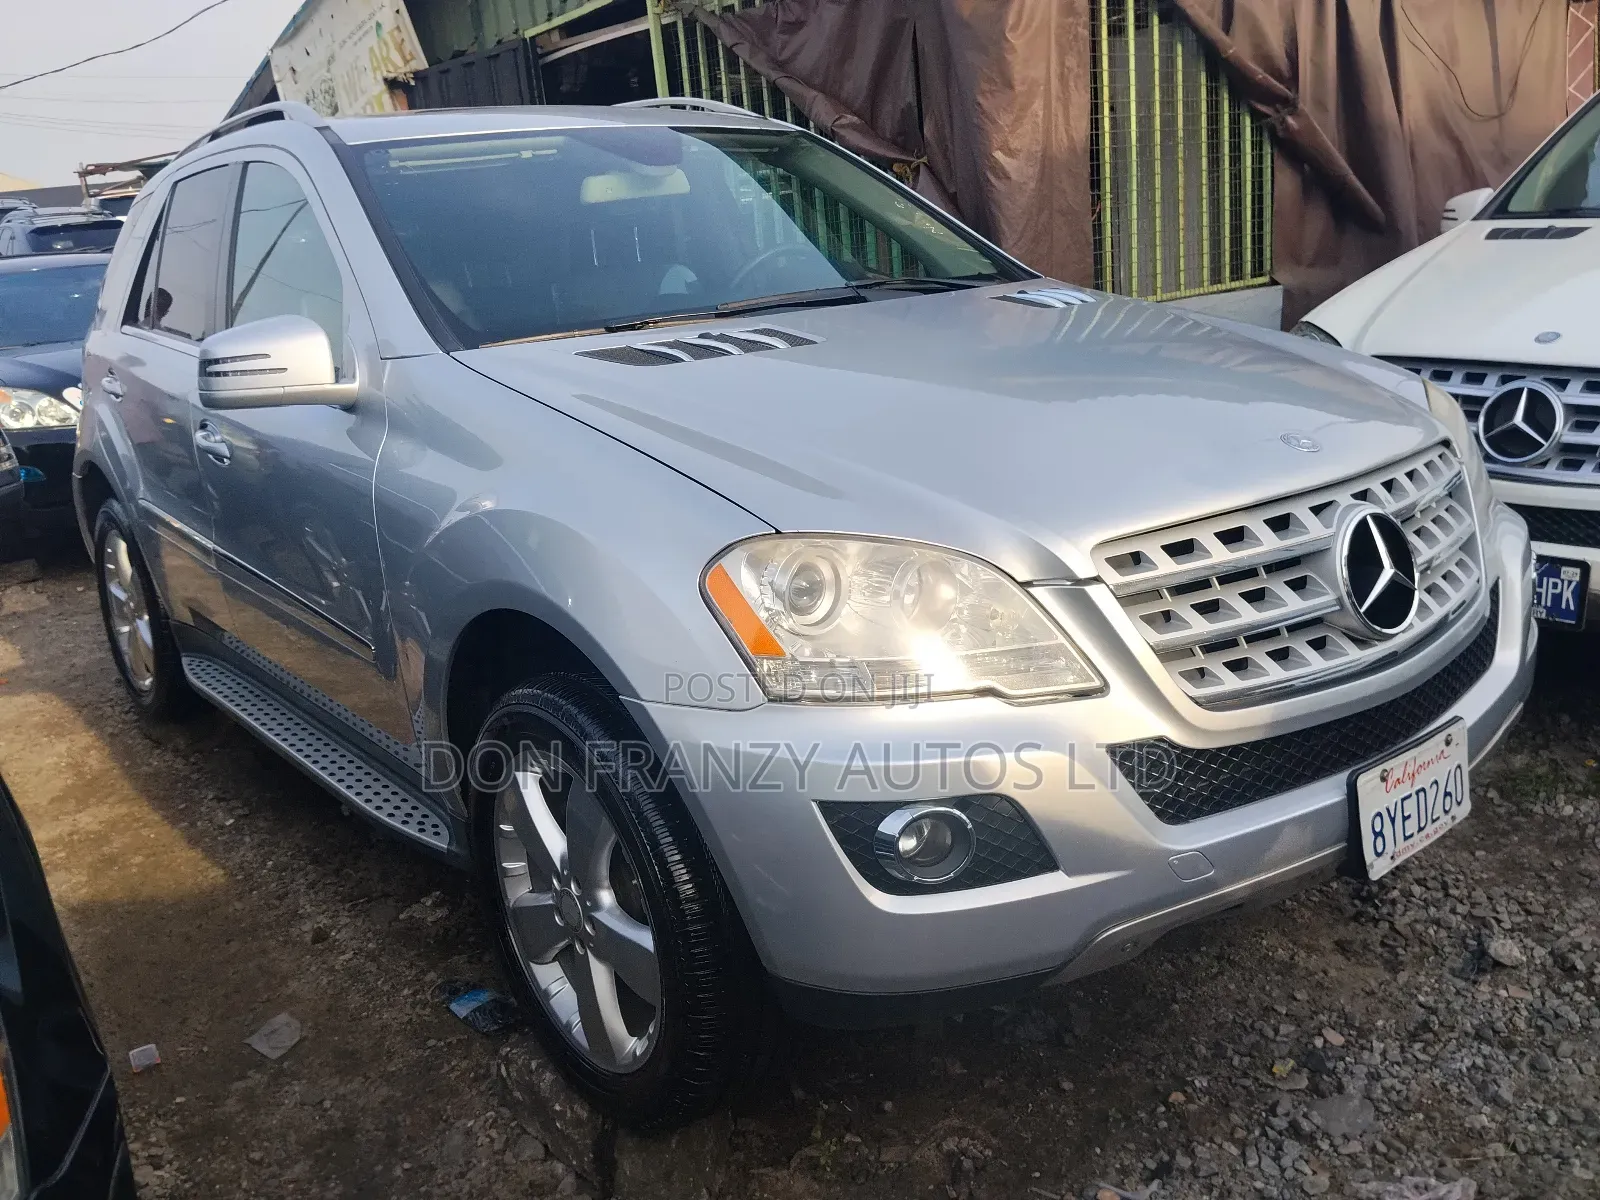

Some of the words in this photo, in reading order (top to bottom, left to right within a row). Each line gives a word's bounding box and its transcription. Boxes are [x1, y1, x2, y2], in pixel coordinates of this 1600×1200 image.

[368, 25, 417, 81] ARE
[1385, 749, 1451, 794] California
[1371, 763, 1464, 858] 8YED260
